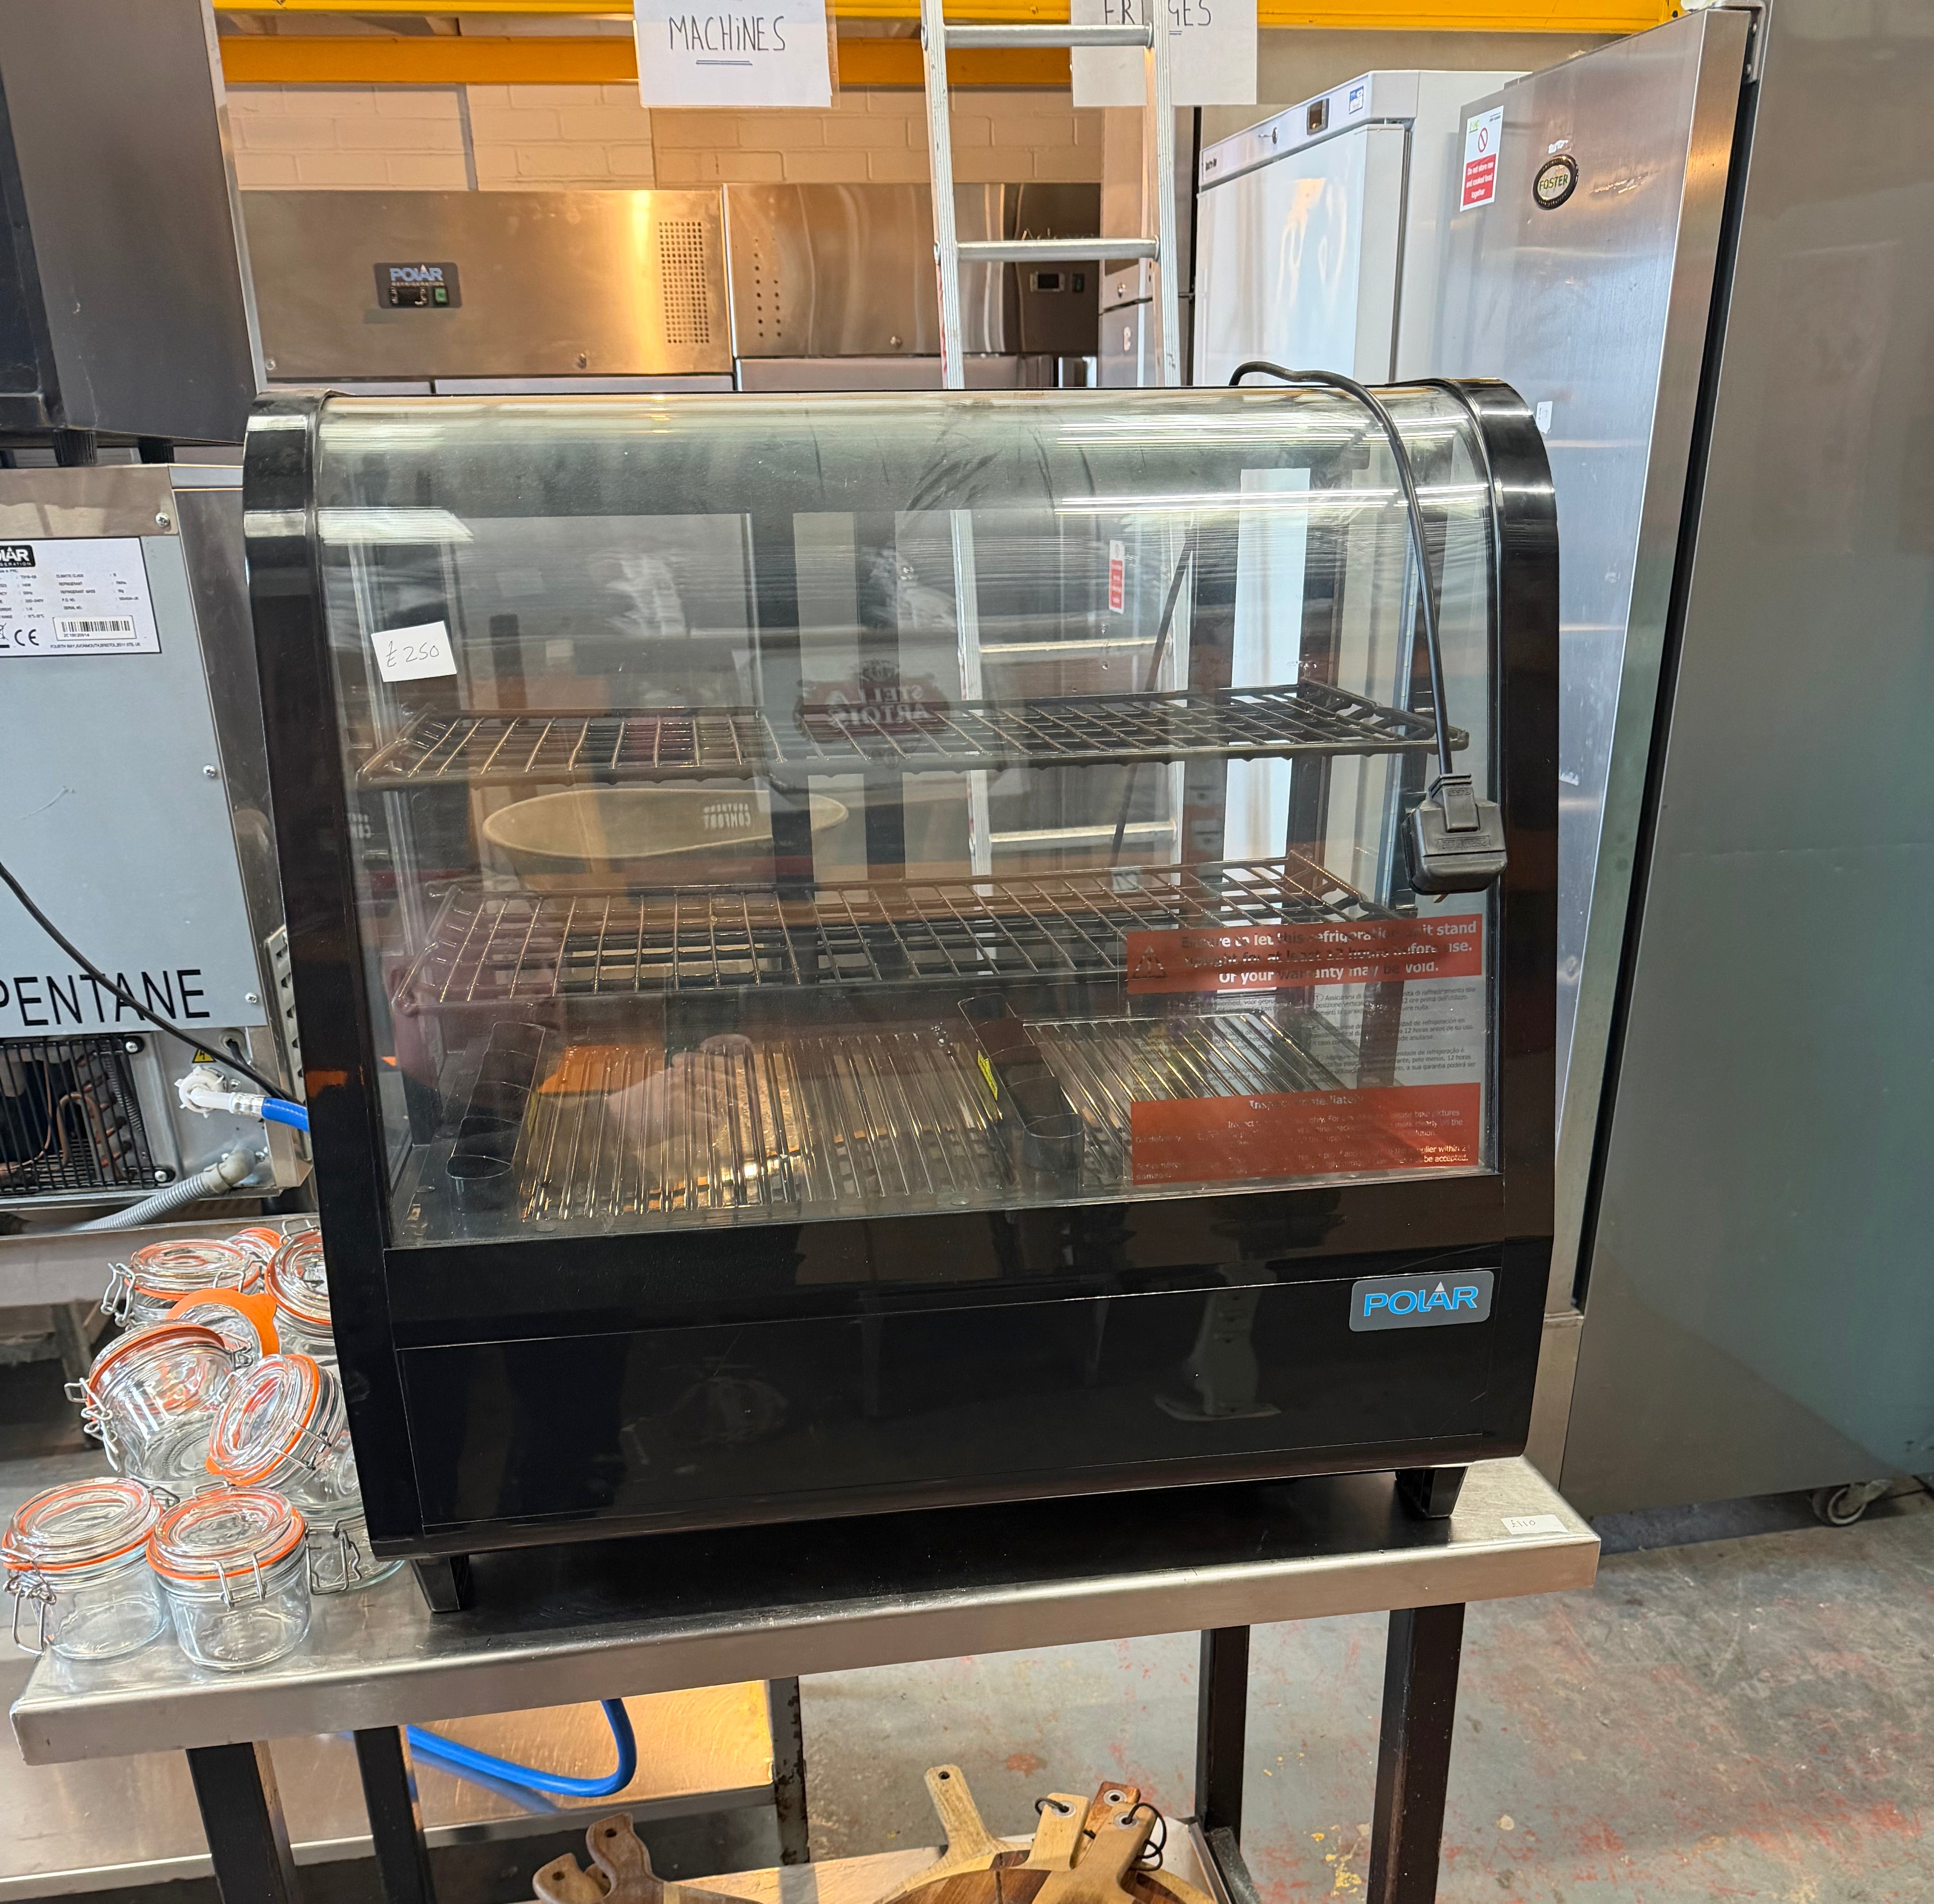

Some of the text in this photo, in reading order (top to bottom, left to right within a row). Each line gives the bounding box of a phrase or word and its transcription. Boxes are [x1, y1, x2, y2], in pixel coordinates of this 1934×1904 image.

[1104, 0, 1211, 26] FRIGES
[1539, 174, 1568, 191] FOSTER
[389, 264, 443, 282] POLAR
[0, 546, 30, 562] LAR
[1254, 933, 1274, 946] let
[1436, 921, 1476, 936] stand
[1444, 942, 1473, 953] se.
[1240, 971, 1275, 986] your
[1405, 961, 1439, 974] void.
[1258, 997, 1275, 1005] gebru
[1424, 1153, 1469, 1164] be accepted.
[1364, 1281, 1478, 1317] POLAR
